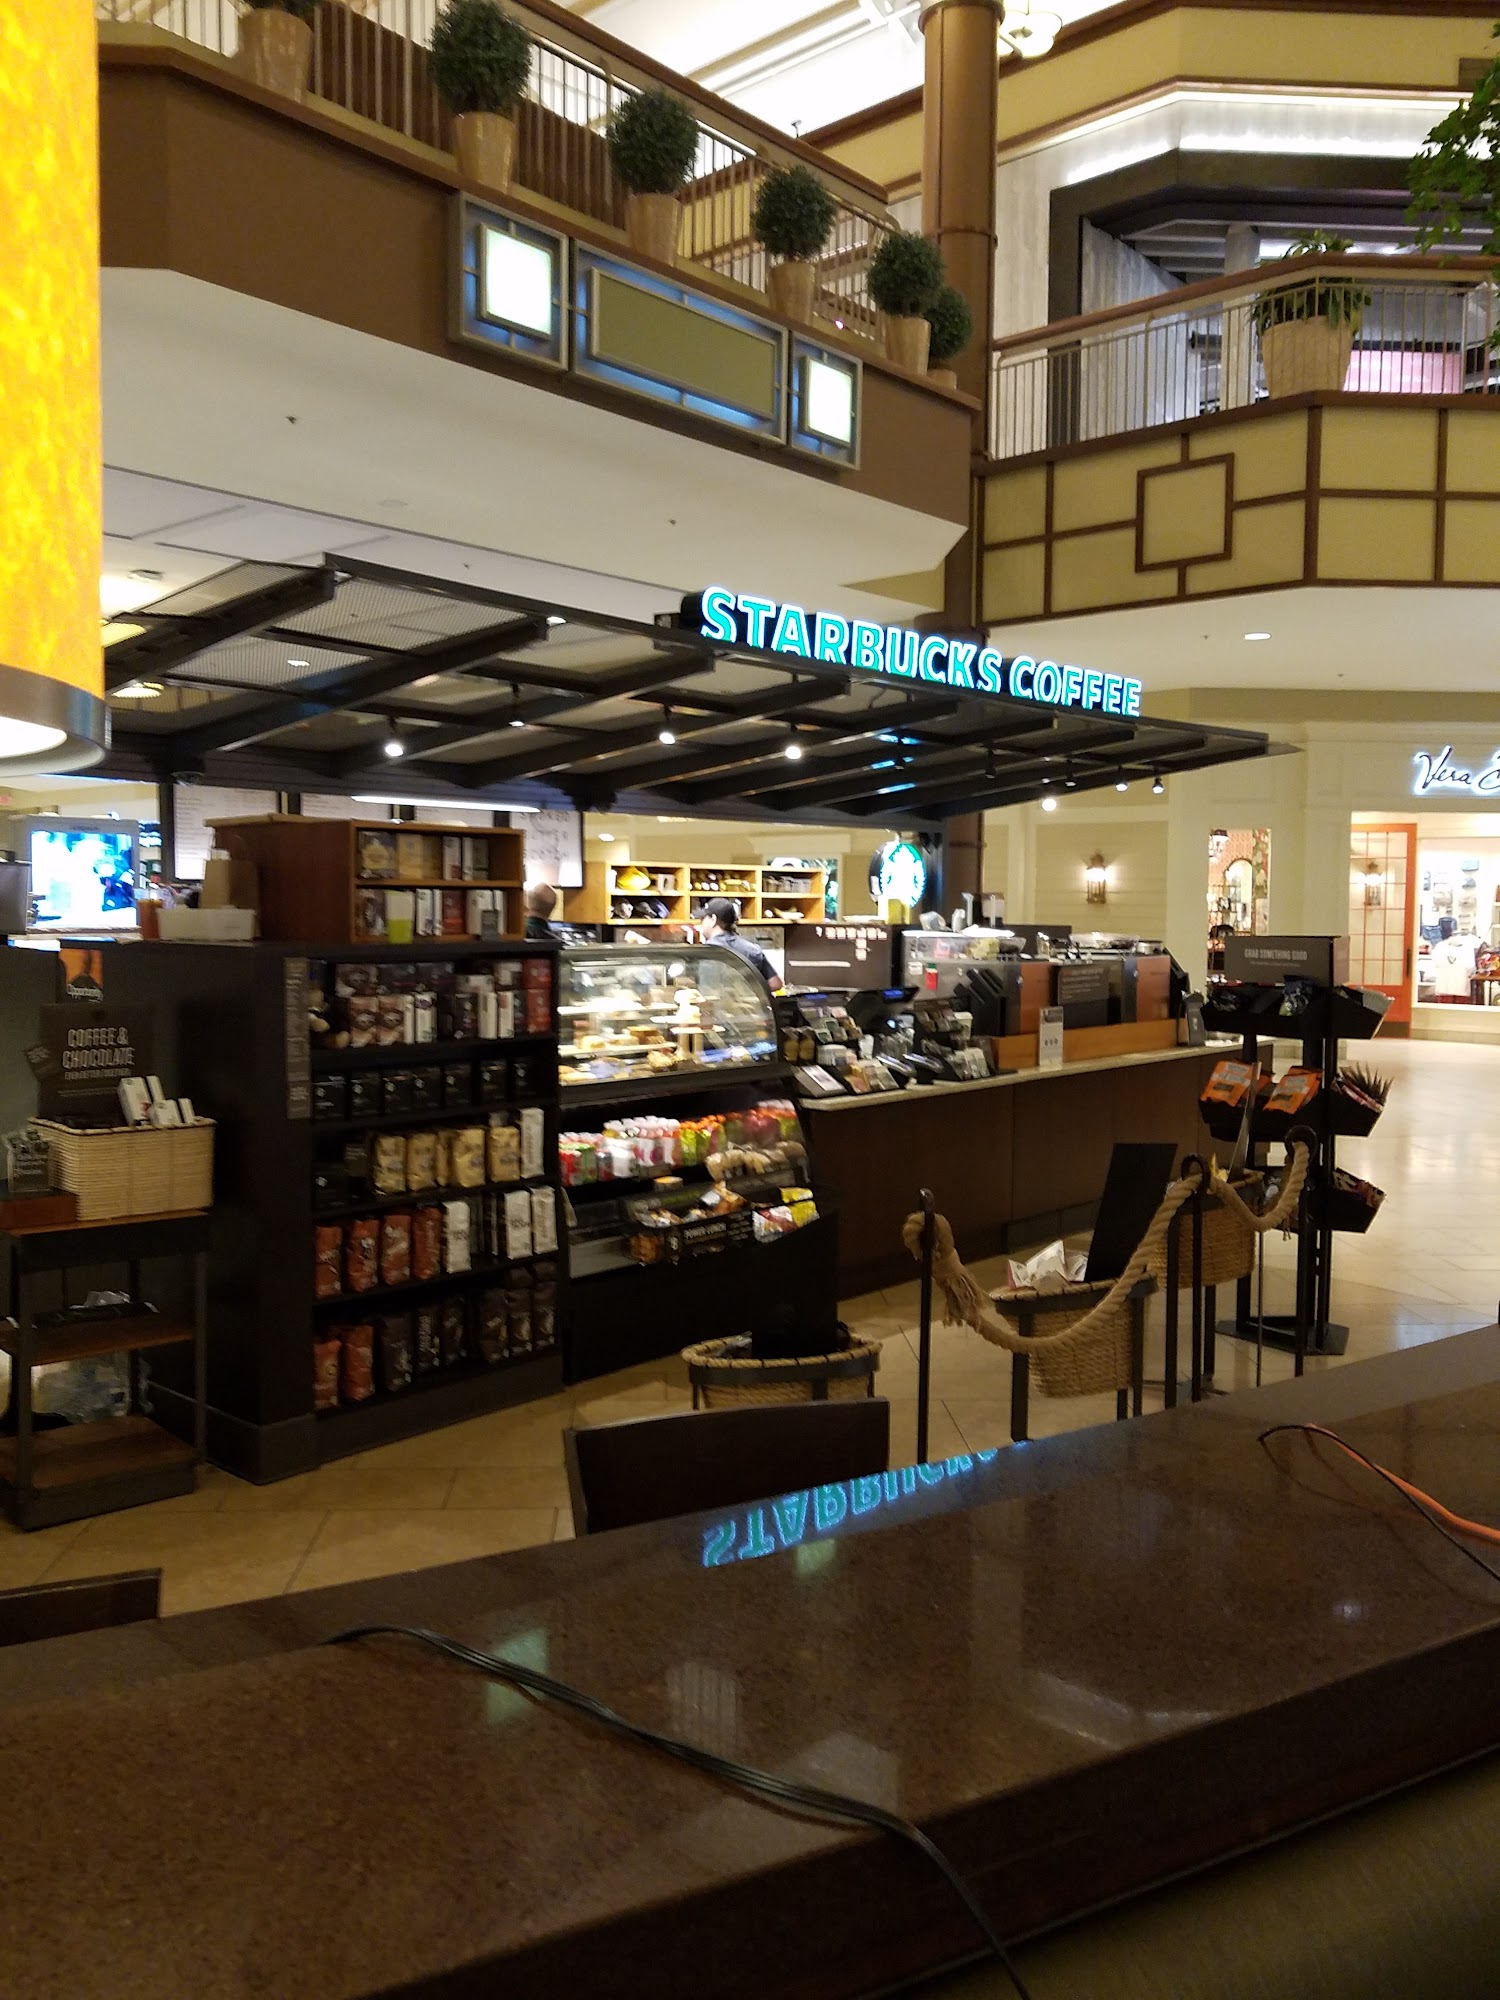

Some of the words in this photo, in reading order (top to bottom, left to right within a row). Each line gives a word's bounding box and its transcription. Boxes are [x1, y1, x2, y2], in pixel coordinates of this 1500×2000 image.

[700, 586, 1002, 694] STARBUCKS
[1008, 655, 1143, 718] COFFEE
[1417, 746, 1472, 790] Vera
[67, 1026, 117, 1047] COFFEE
[116, 1025, 129, 1045] &
[62, 1047, 136, 1070] CHOCOLATE
